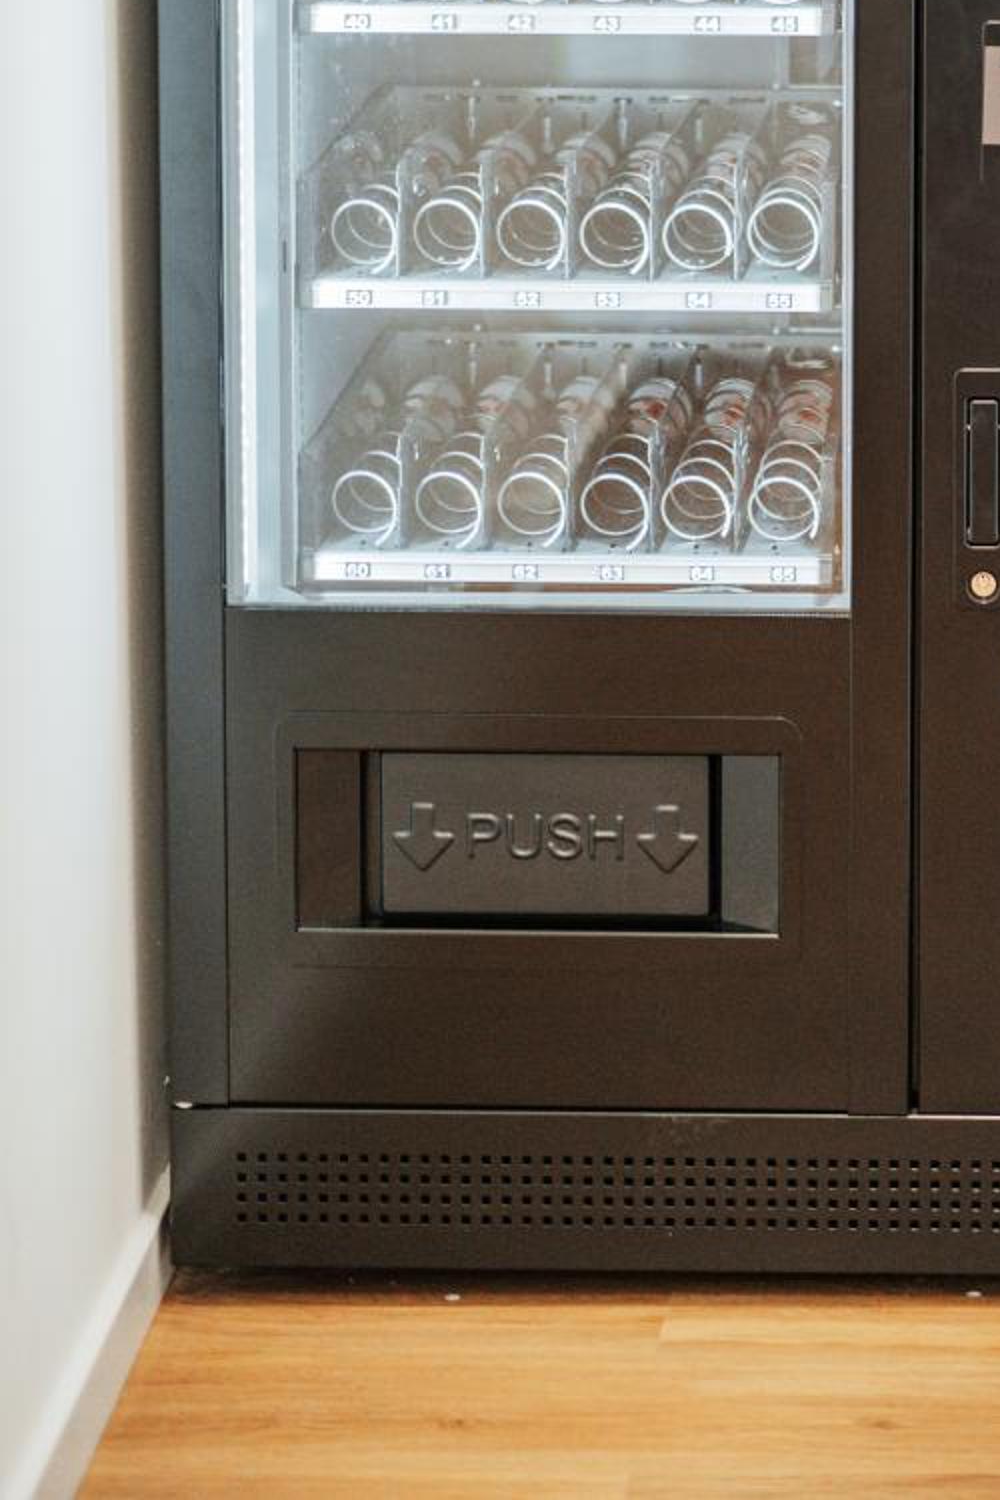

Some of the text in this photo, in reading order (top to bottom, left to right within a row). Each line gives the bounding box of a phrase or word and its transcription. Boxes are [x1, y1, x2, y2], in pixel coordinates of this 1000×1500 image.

[433, 14, 457, 29] 41
[695, 17, 721, 31] 44
[466, 812, 626, 861] PUSH
